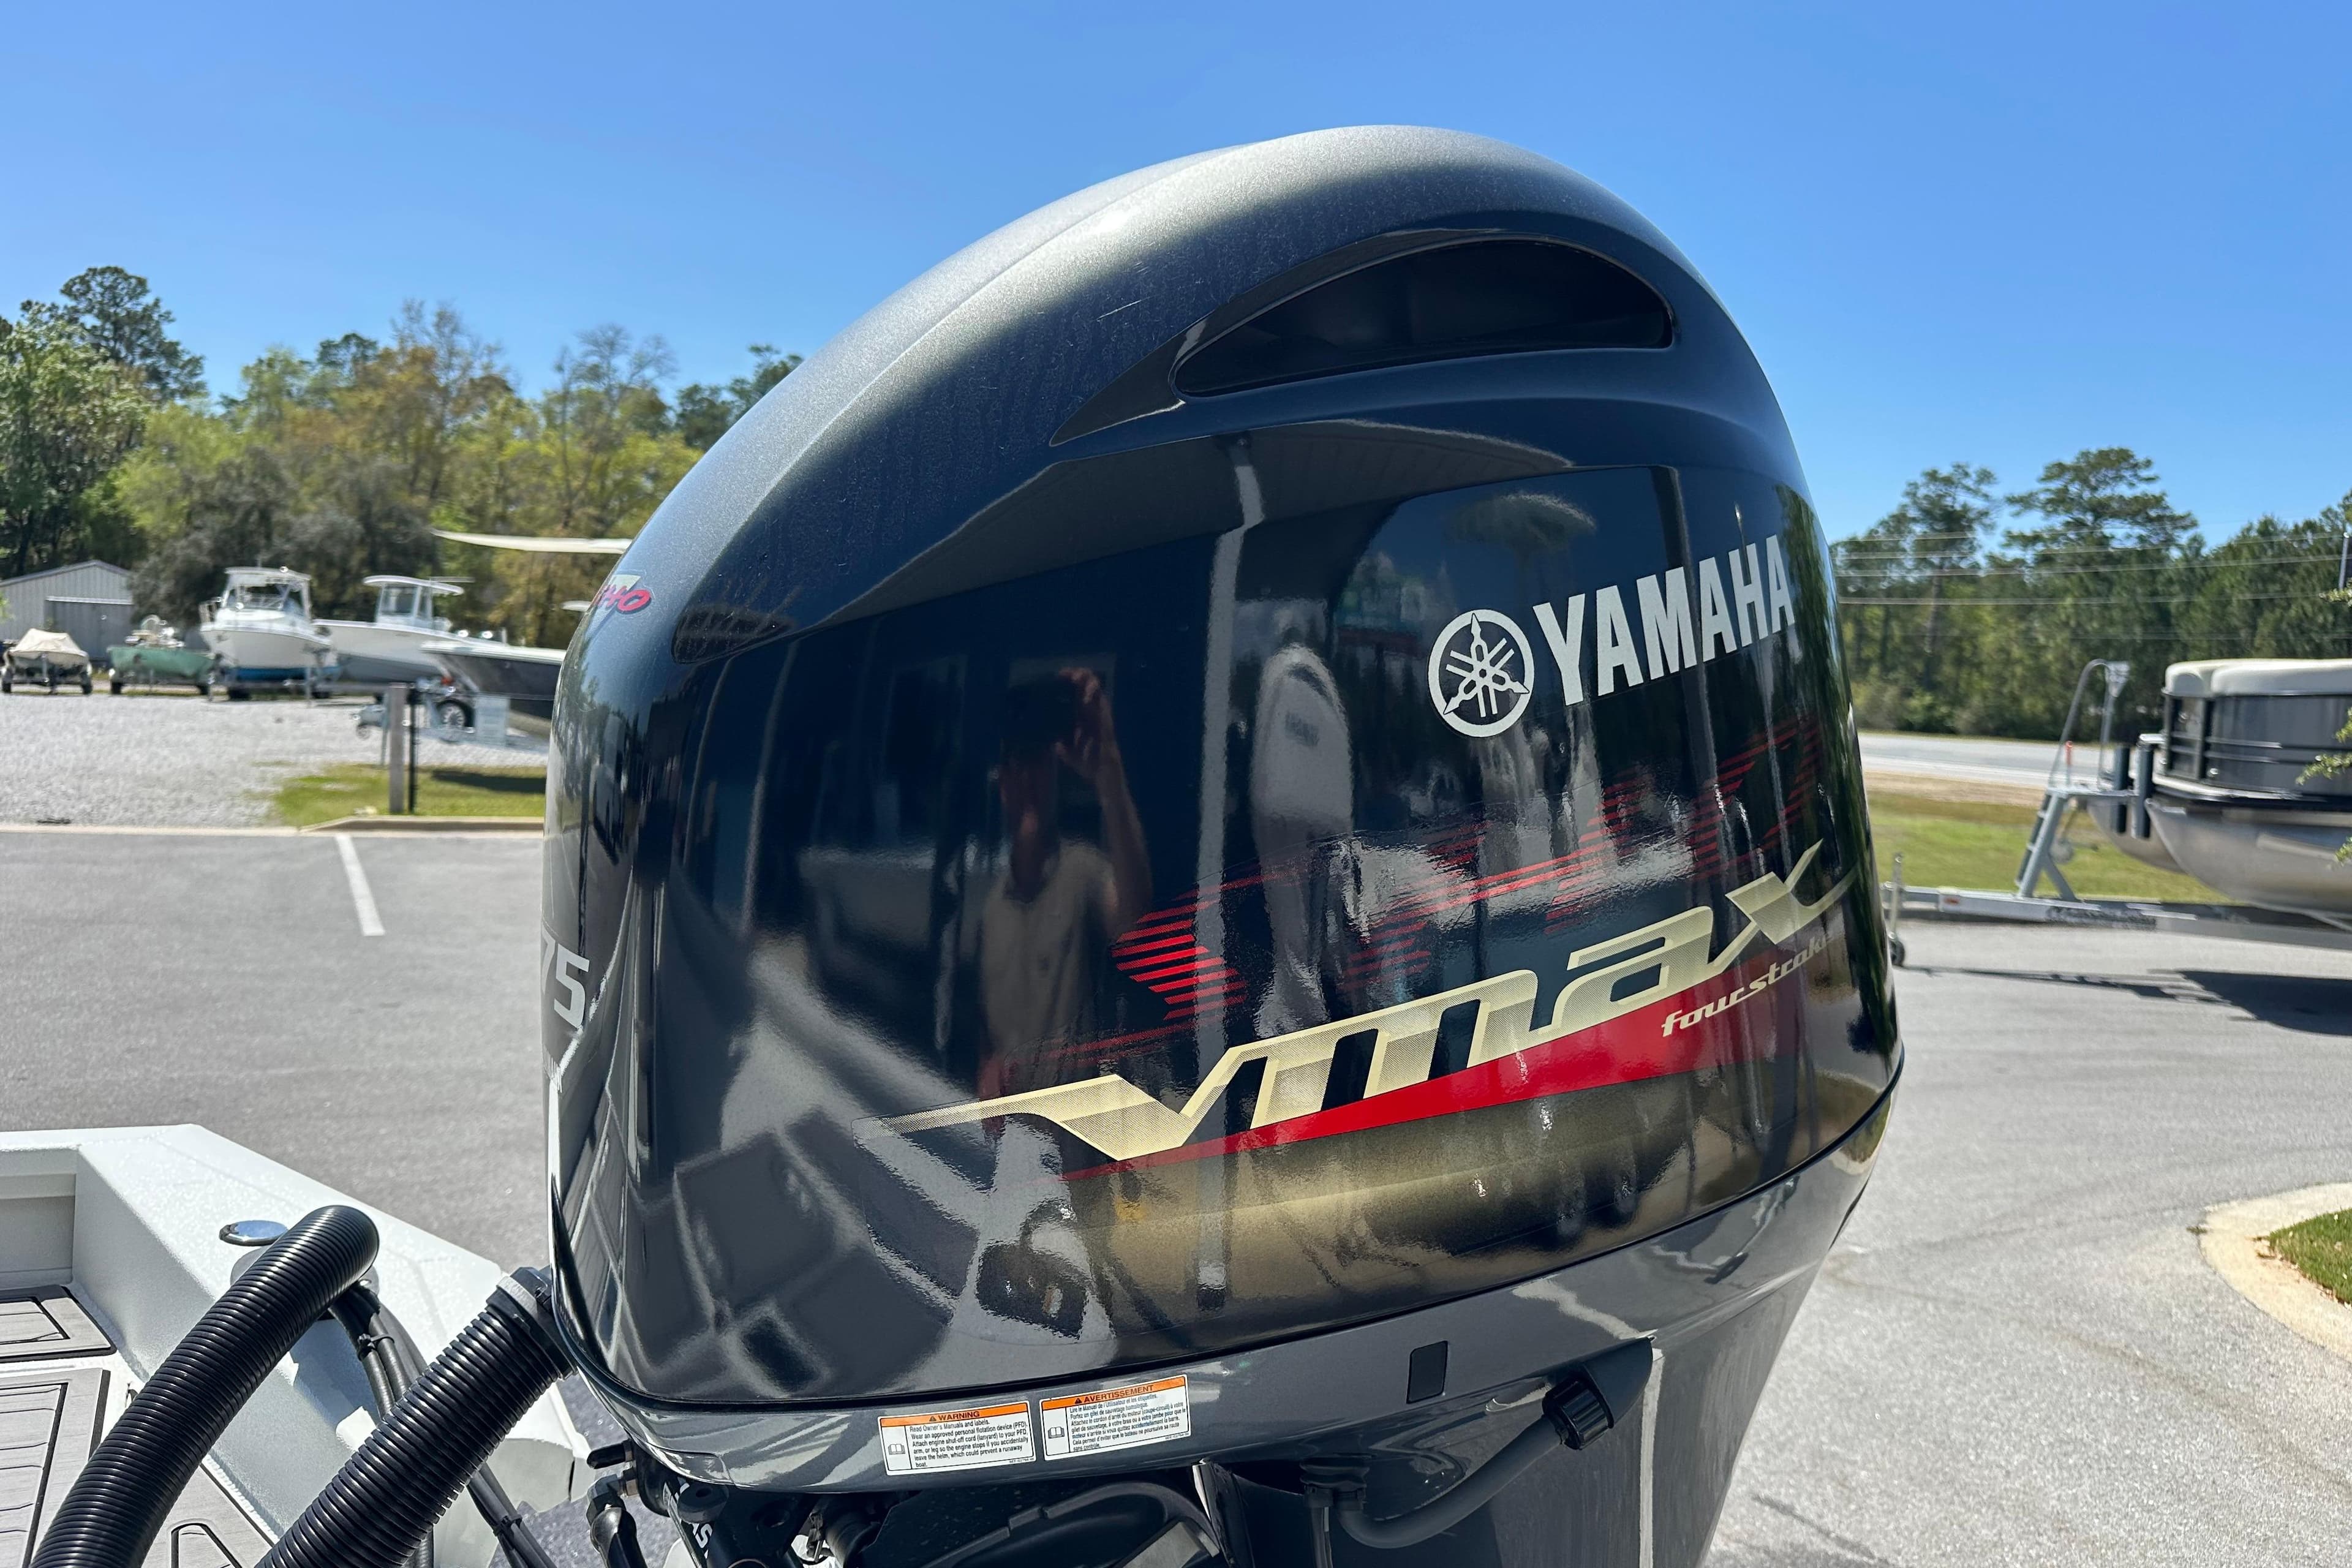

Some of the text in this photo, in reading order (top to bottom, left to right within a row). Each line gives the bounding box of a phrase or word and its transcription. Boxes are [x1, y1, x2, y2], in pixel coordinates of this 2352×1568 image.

[1532, 534, 1795, 706] YAMAHA
[1085, 1386, 1153, 1402] AVERTISSEMENT
[938, 1412, 980, 1420] WARNING
[977, 1433, 998, 1442] (lanyard)
[1000, 1437, 1028, 1446] accidentally
